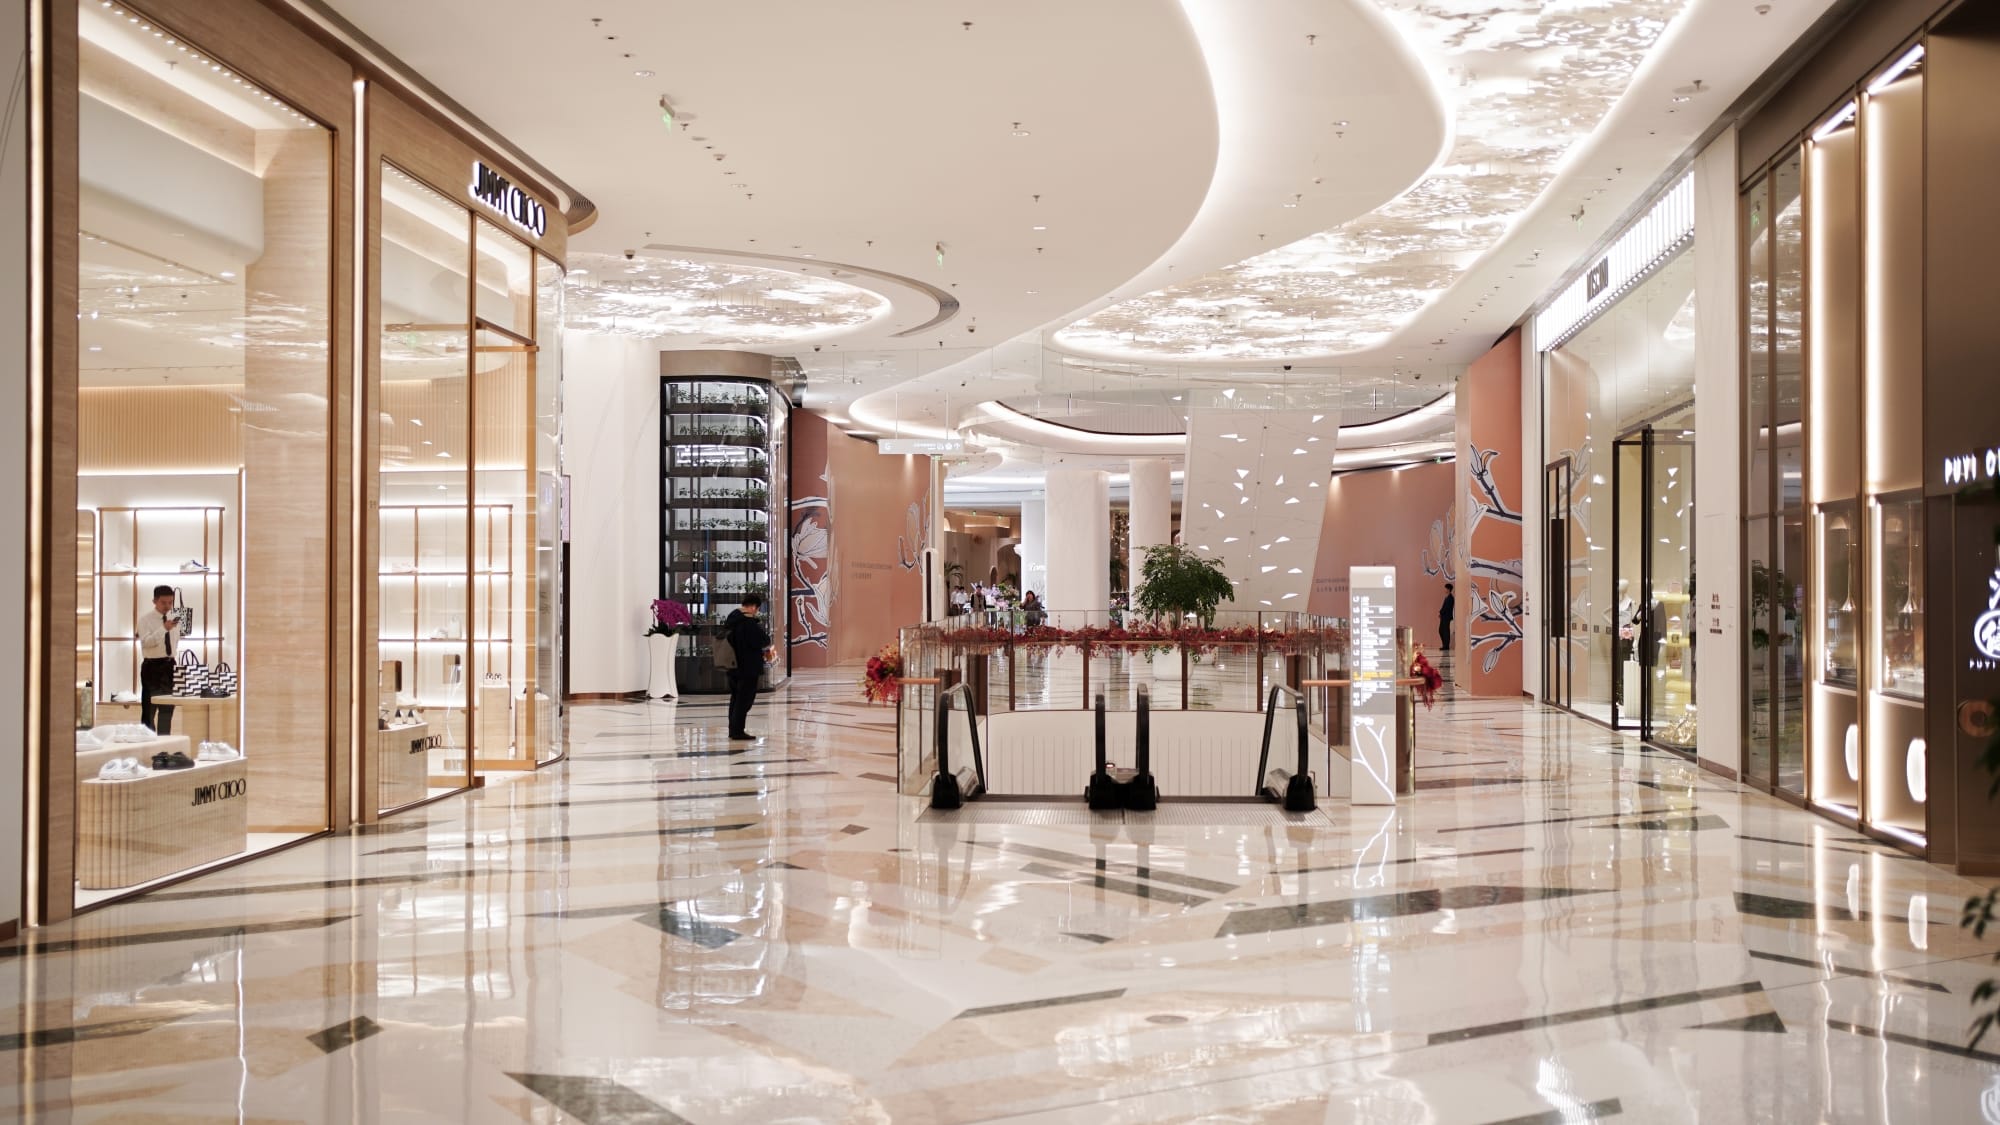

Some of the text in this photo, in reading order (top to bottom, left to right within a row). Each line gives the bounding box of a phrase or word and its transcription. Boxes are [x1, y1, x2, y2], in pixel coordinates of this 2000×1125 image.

[473, 162, 547, 237] JIMMY CHOO
[1944, 447, 2000, 486] PUYI O
[1969, 658, 1996, 670] PUYI
[191, 777, 247, 807] JIMMY CHOO
